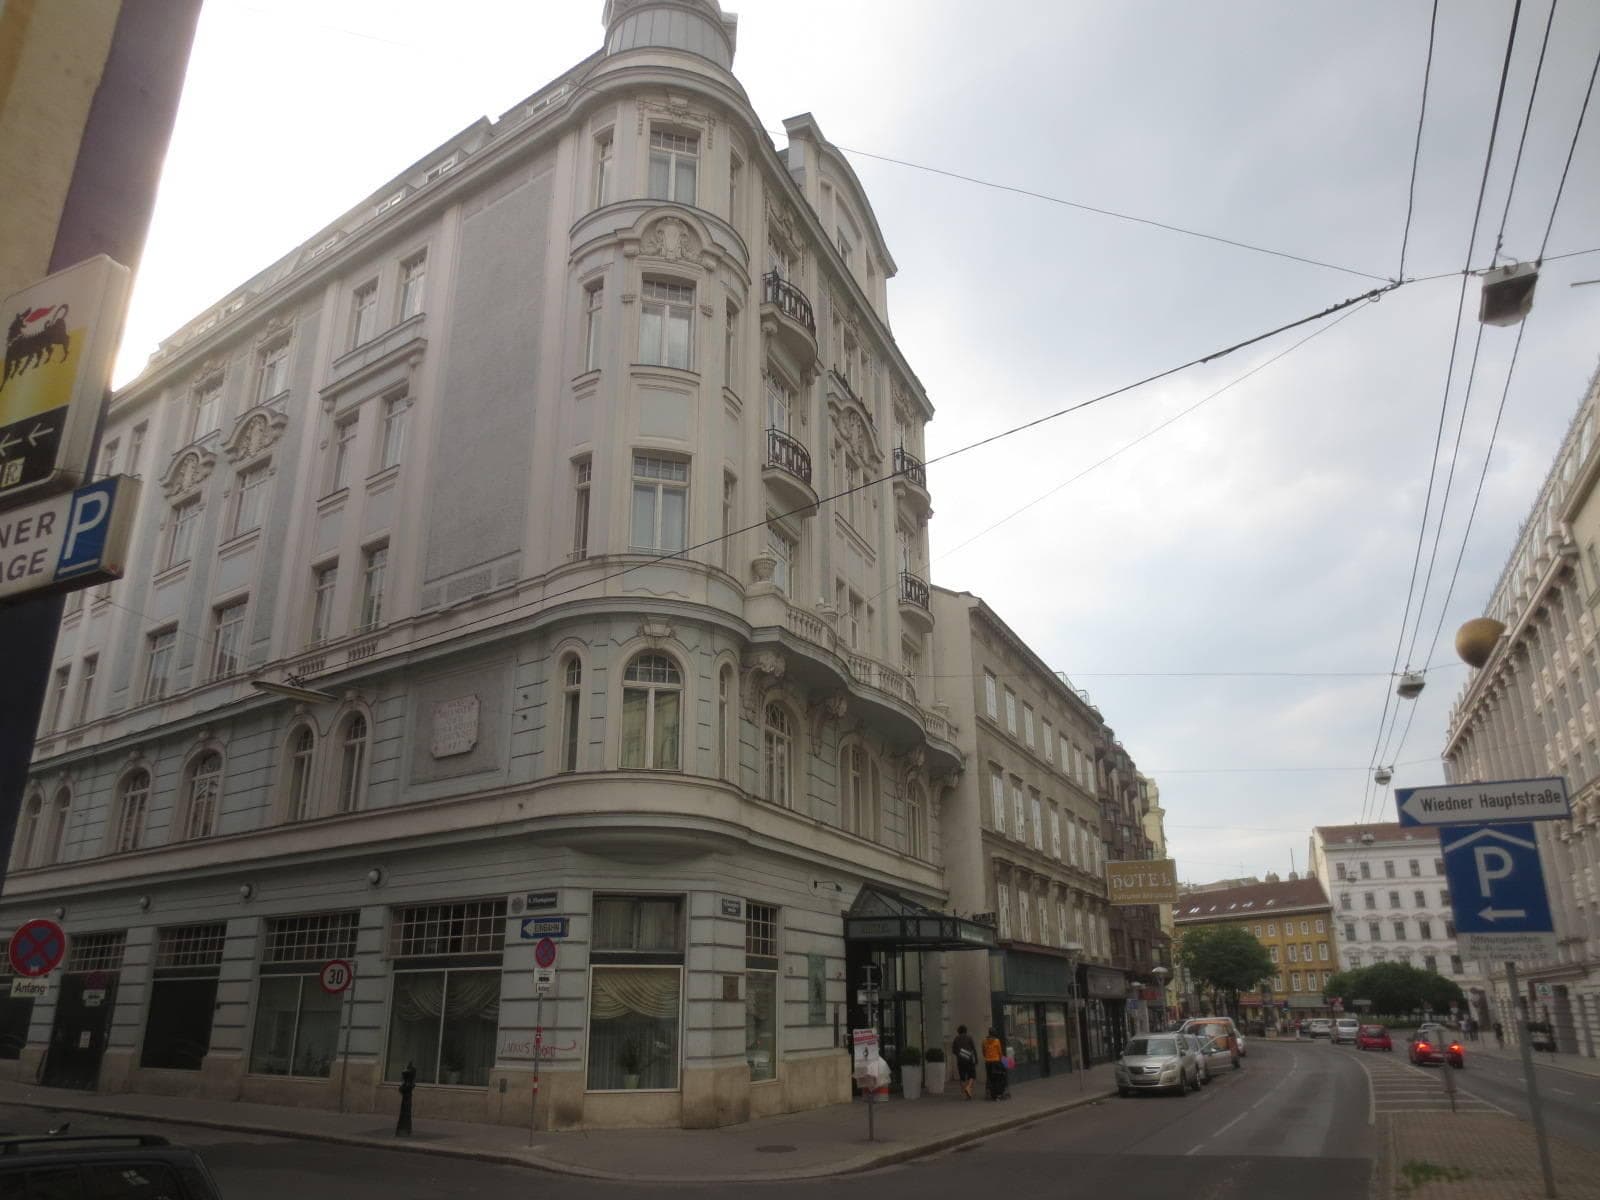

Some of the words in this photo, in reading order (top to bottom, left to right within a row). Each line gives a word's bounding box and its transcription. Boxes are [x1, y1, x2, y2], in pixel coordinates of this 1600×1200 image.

[63, 491, 109, 560] P
[0, 549, 48, 583] GE
[1420, 797, 1473, 812] Wiedner
[1479, 789, 1561, 810] Hauptstraße
[1112, 872, 1171, 890] HOTEL
[1474, 846, 1514, 897] P
[15, 982, 47, 995] Anfang
[328, 969, 344, 985] 30
